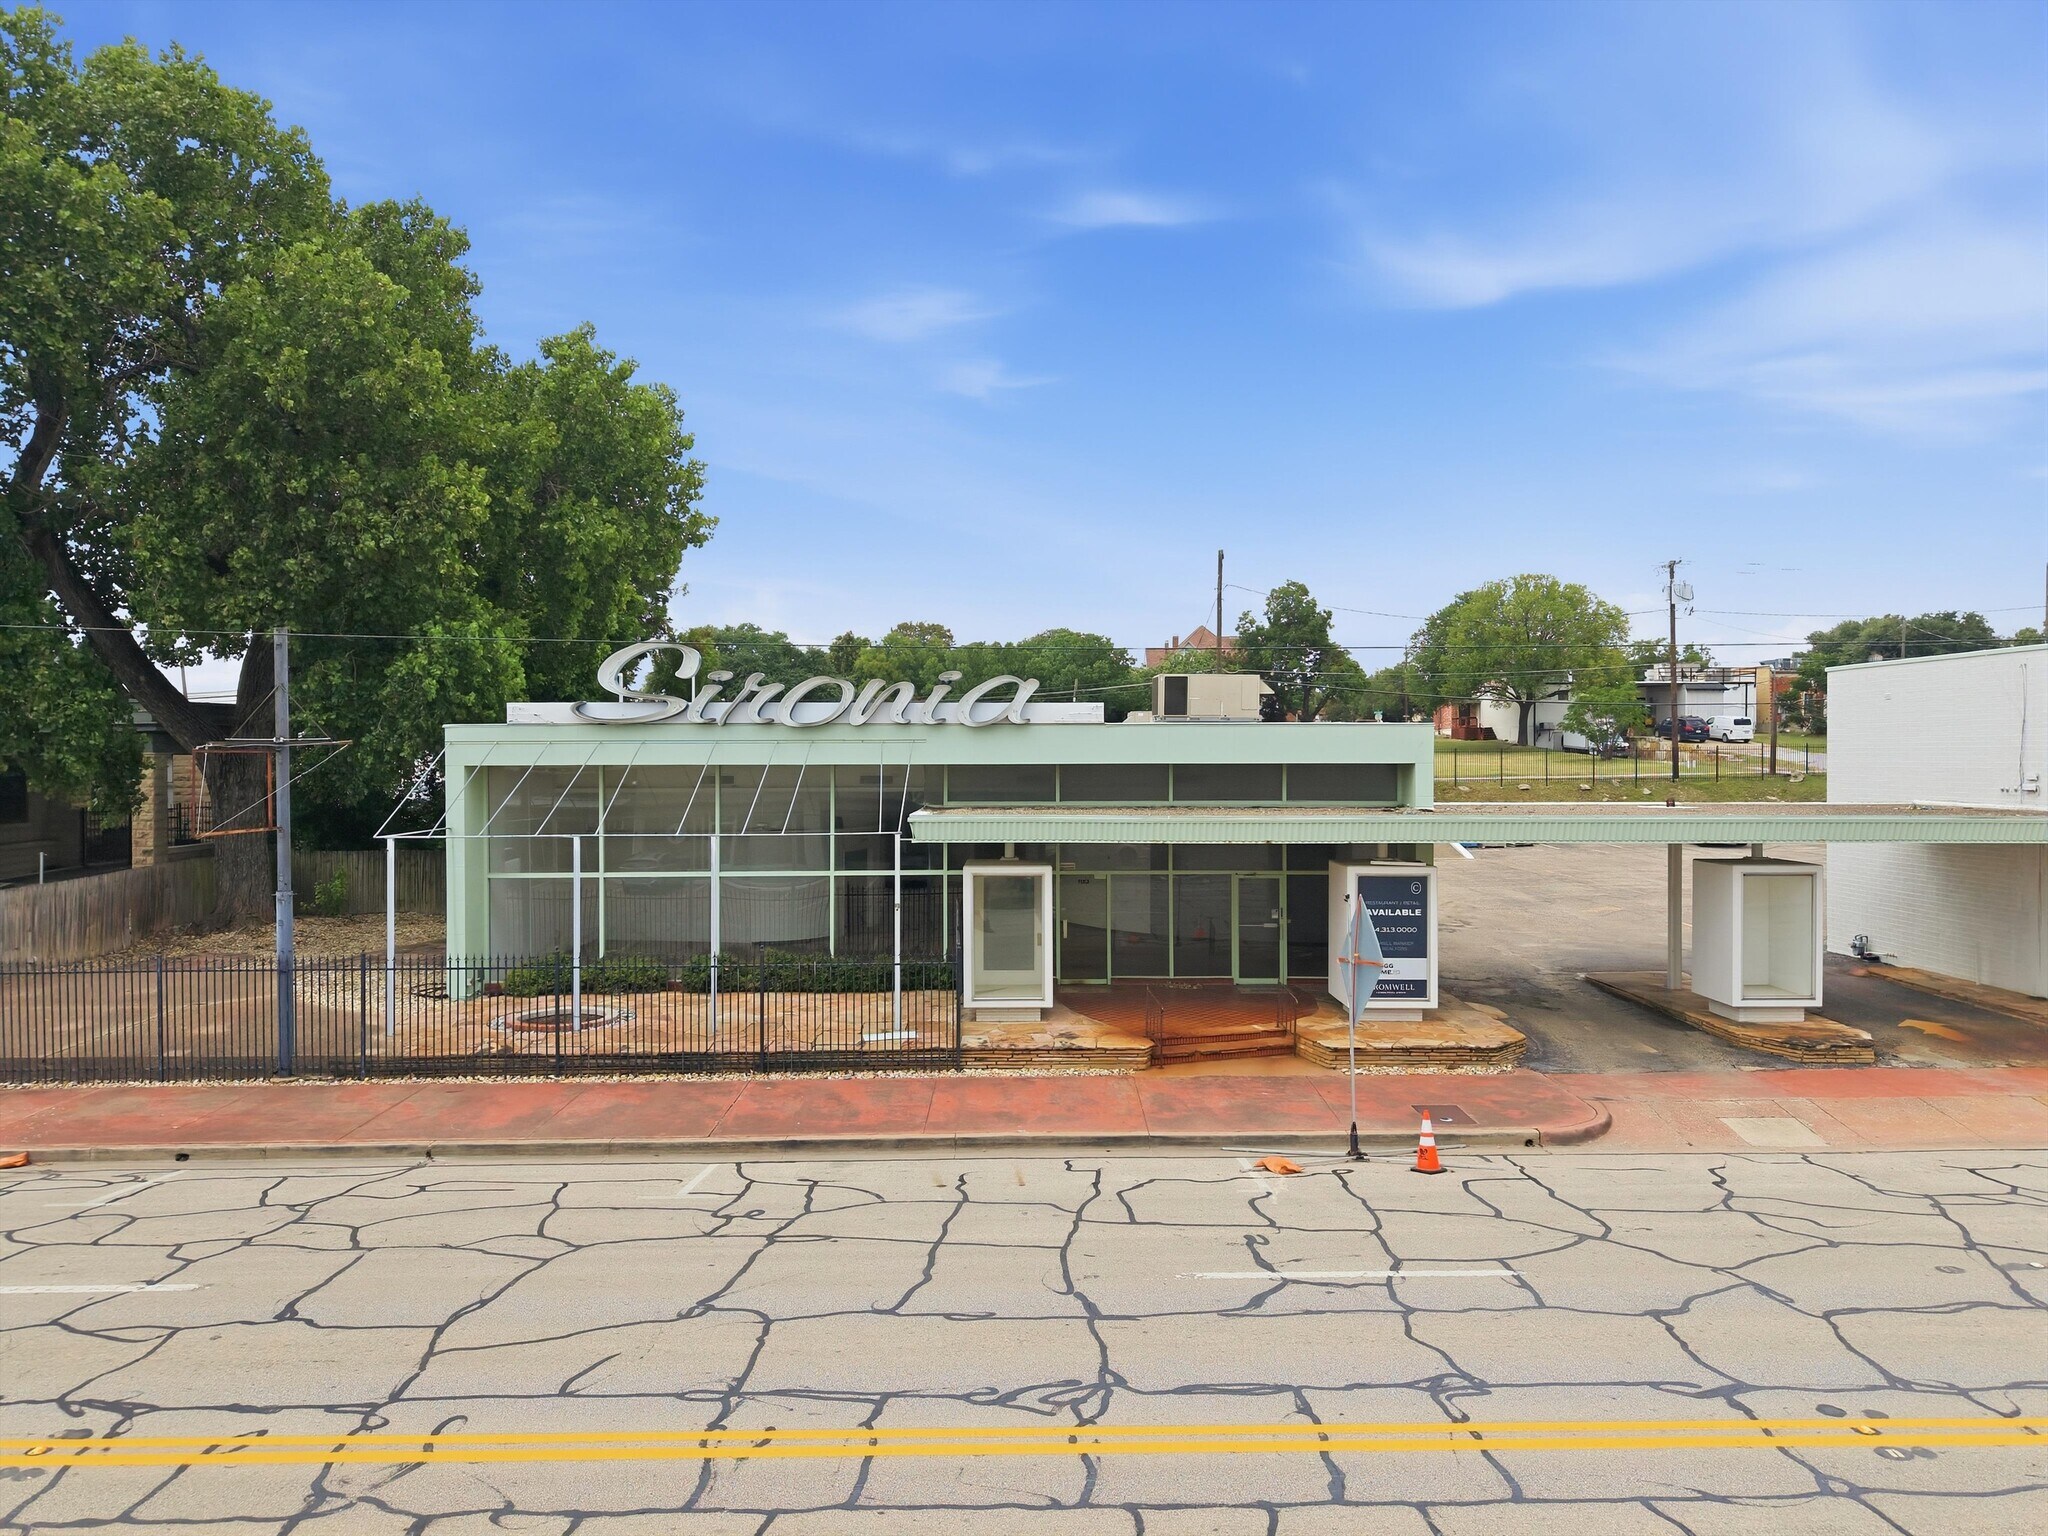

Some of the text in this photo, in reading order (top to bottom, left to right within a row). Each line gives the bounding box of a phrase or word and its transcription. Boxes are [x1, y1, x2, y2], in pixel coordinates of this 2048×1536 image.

[569, 639, 1041, 728] Sironia
[1367, 908, 1422, 916] AVAILABLE
[1374, 983, 1416, 991] ROMWELL
